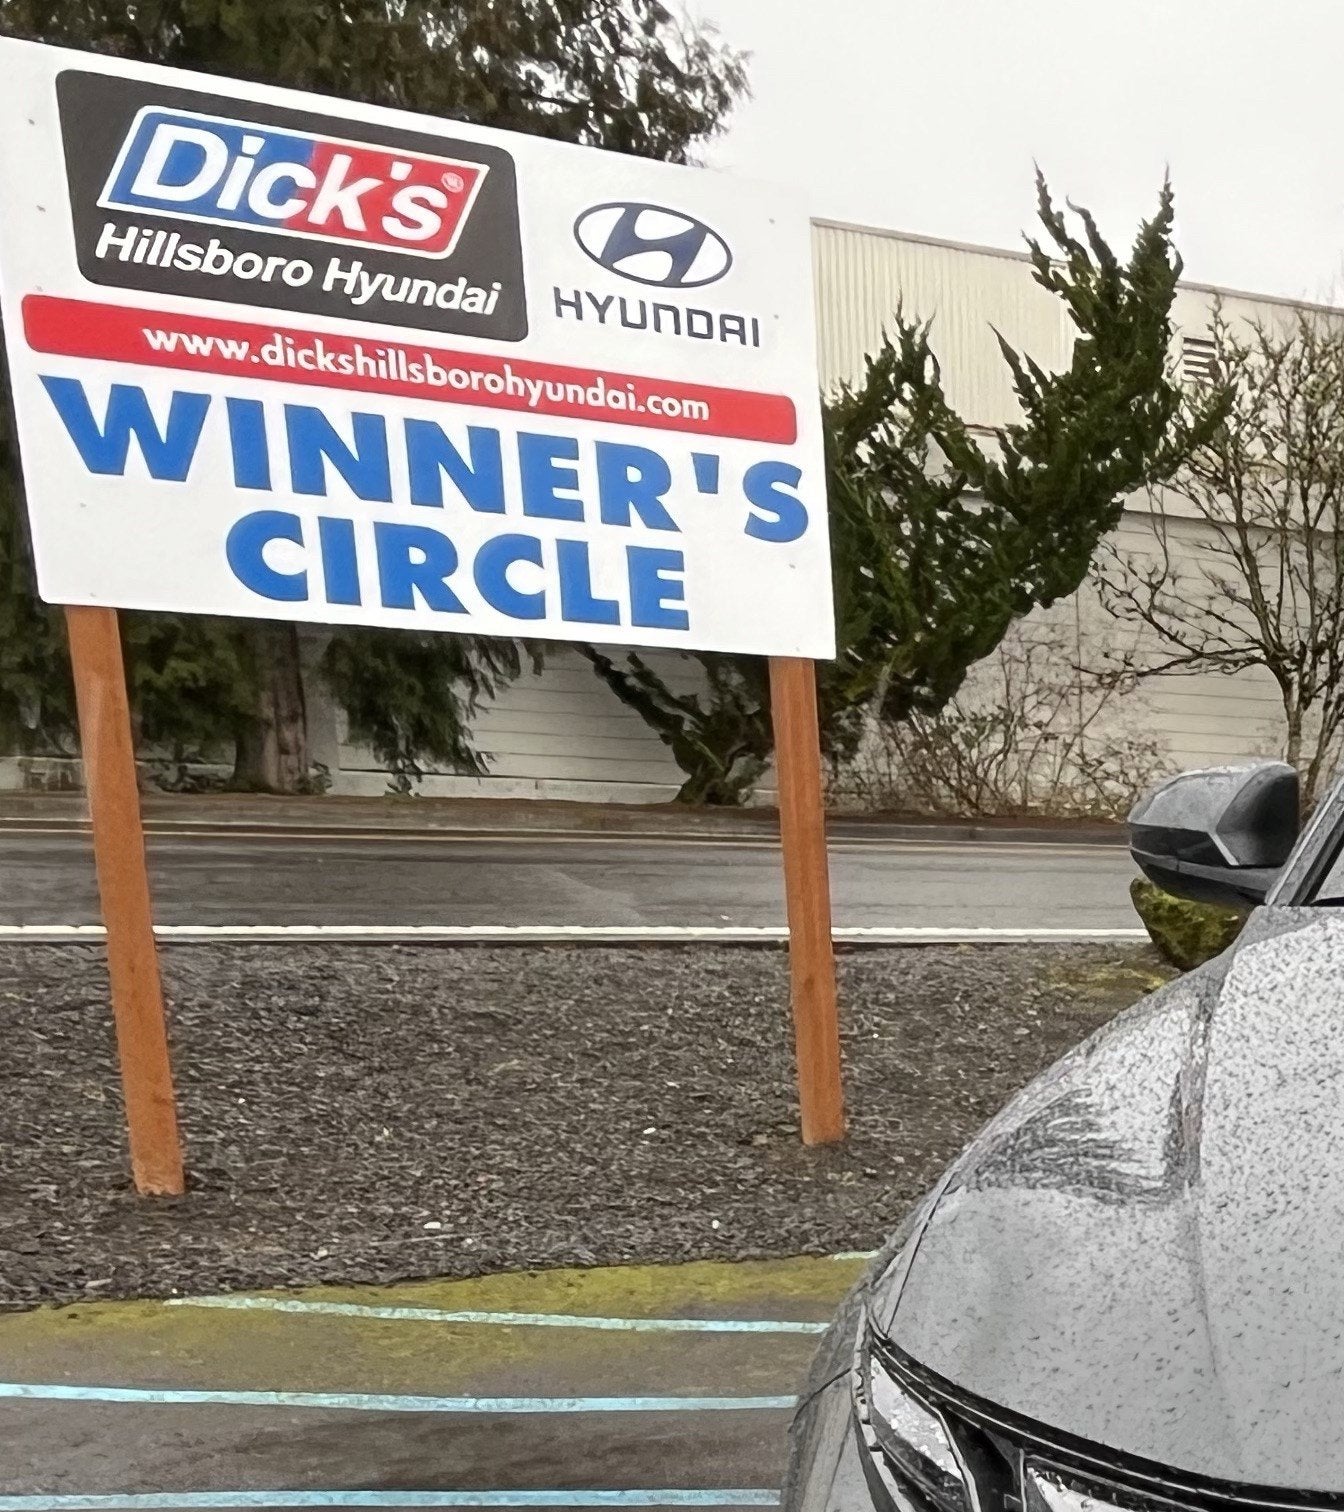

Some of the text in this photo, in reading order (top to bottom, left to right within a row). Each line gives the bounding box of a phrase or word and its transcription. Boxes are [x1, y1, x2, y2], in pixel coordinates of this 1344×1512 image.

[131, 122, 448, 241] Dick's
[95, 222, 502, 315] Hillsboro Hyundai
[553, 286, 760, 347] HYUNDAI
[143, 322, 710, 421] www.dickshillsborohyundai.com
[38, 375, 810, 544] WINNER'S
[226, 510, 689, 630] CIRCLE
